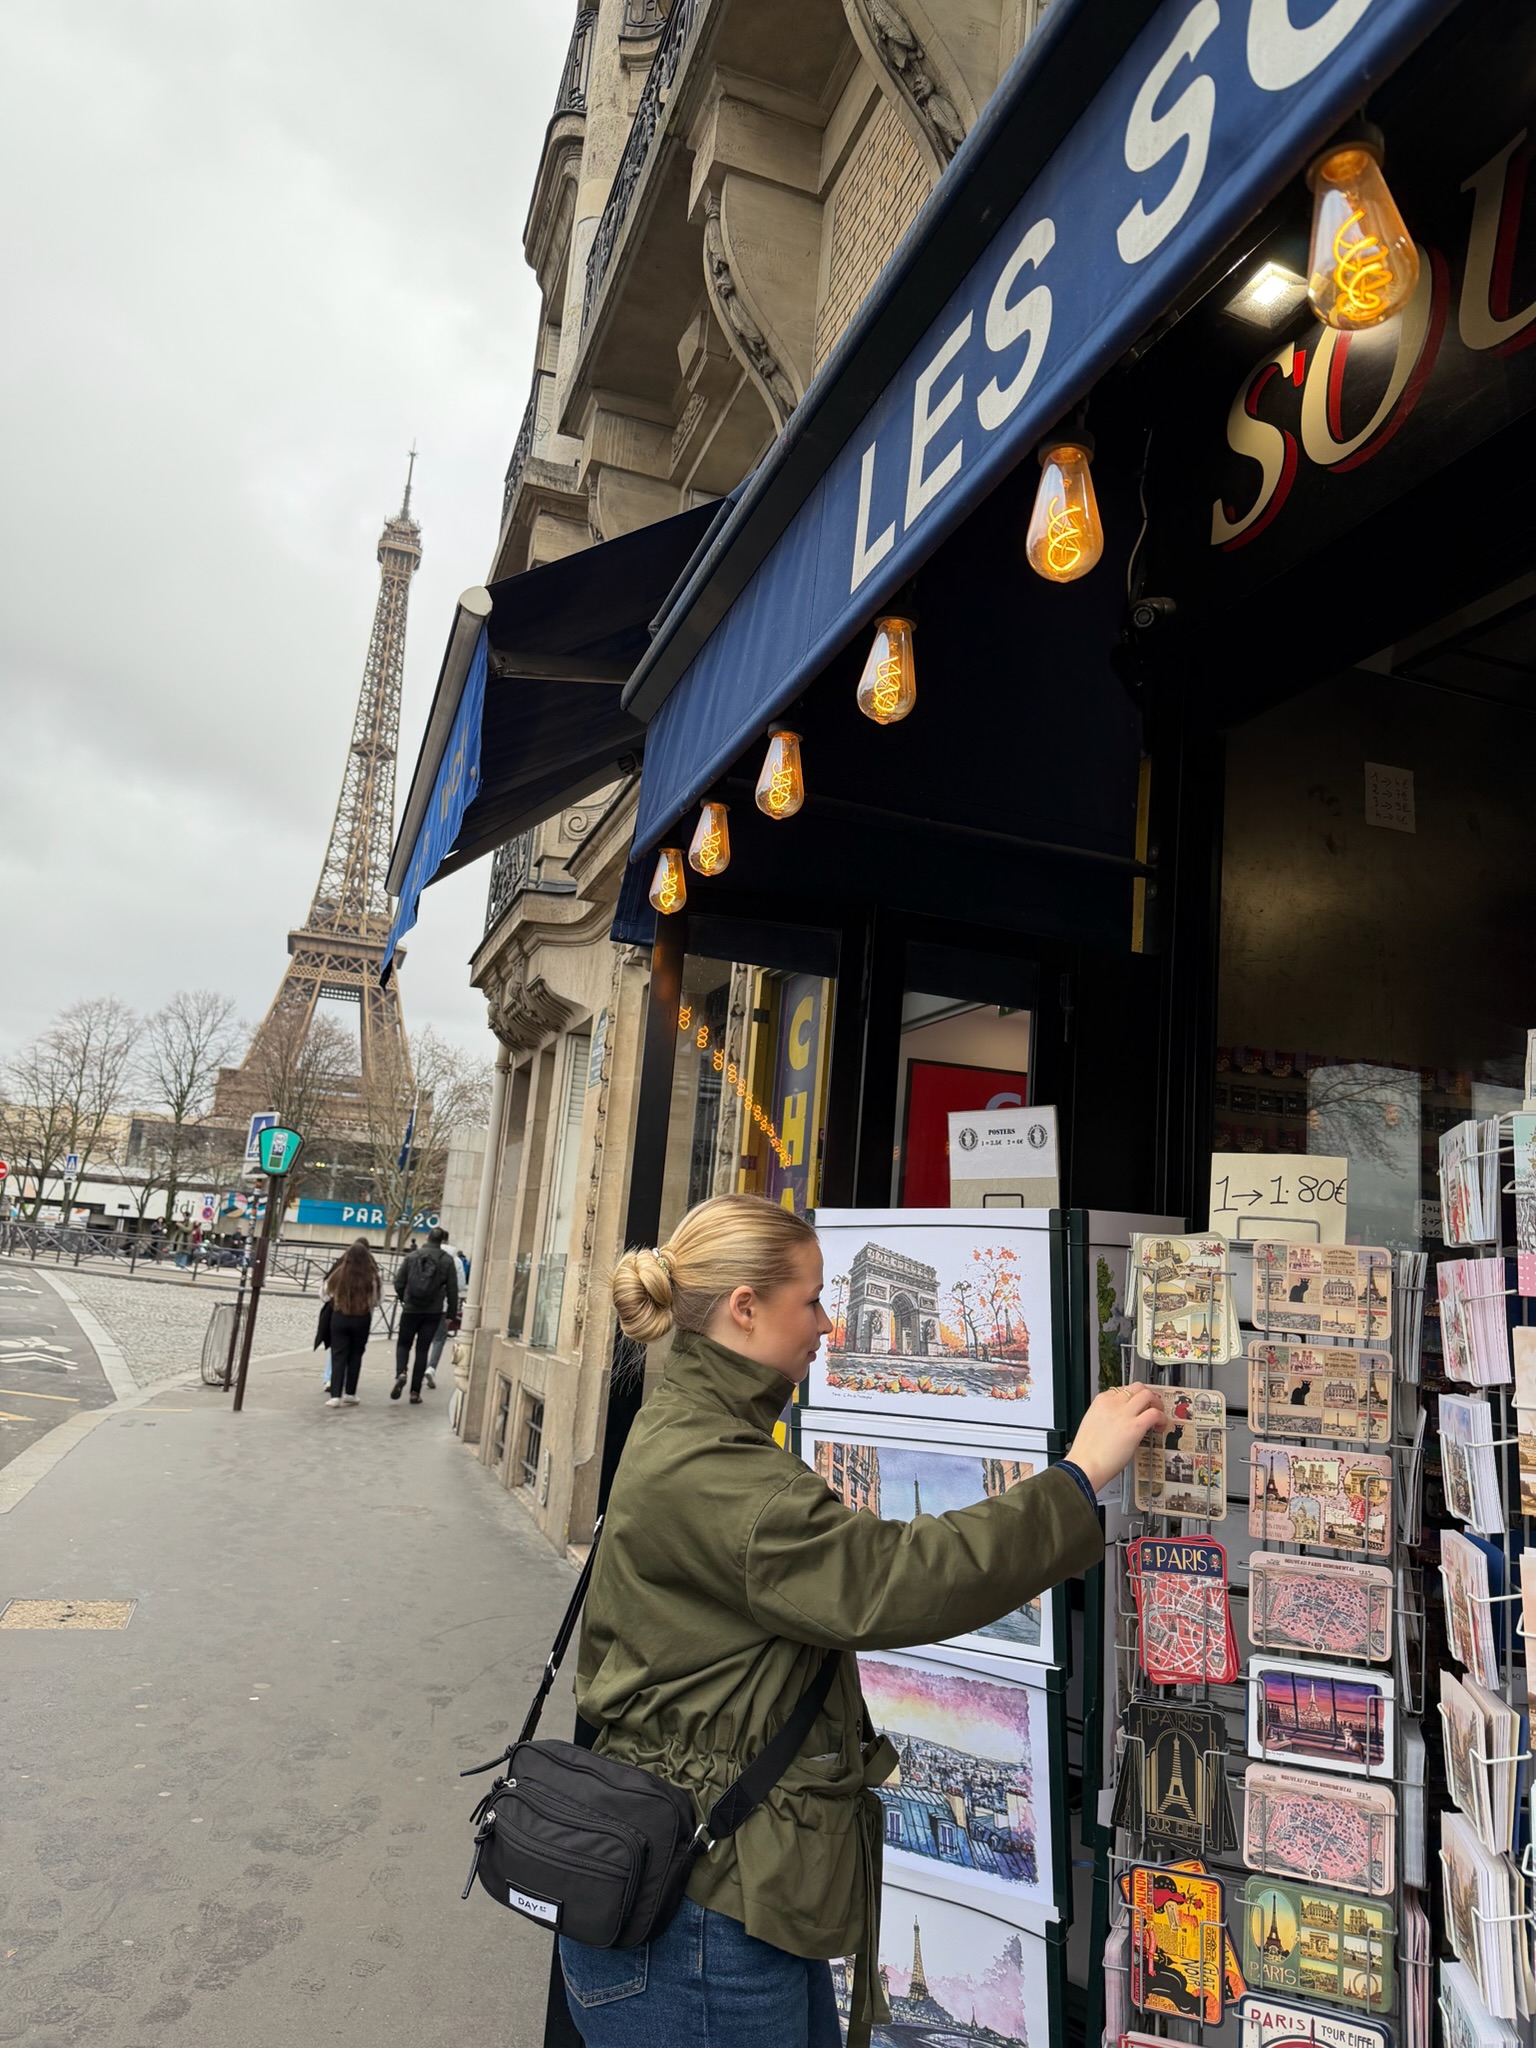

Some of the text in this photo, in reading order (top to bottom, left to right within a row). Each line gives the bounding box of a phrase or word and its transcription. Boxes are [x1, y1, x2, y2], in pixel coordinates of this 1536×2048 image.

[851, 218, 1056, 594] LES
[988, 1128, 1016, 1136] POSTERS
[1213, 1175, 1239, 1213] 1
[1156, 1545, 1208, 1572] PARIS
[1147, 1709, 1204, 1733] PARIS
[1304, 1779, 1319, 1787] PARIS
[1147, 1816, 1171, 1834] OUR
[518, 1897, 538, 1911] DAY
[1180, 1956, 1200, 1988] NOIR
[1249, 1960, 1297, 1985] PARIS
[1250, 2008, 1306, 2031] PARIS
[1321, 2024, 1346, 2041] TOUR
